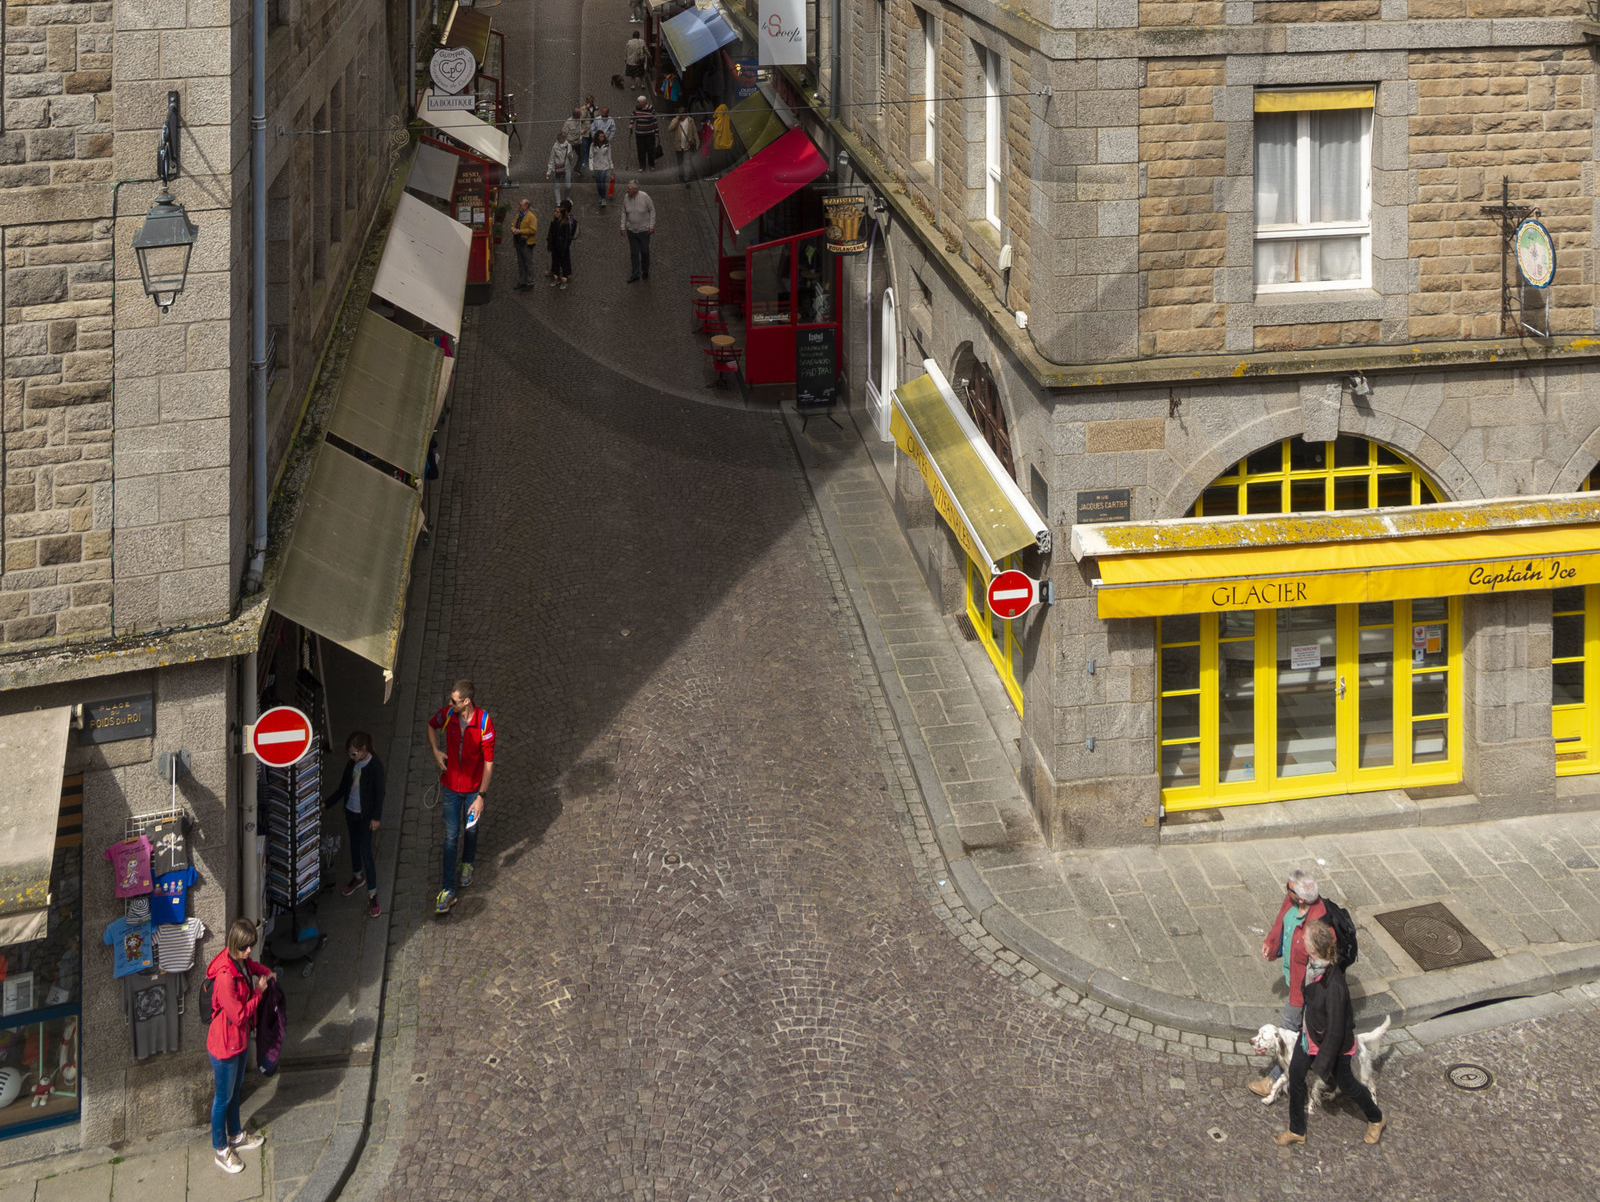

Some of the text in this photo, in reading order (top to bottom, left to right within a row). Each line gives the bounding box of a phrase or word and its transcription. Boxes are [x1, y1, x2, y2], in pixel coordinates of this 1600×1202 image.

[430, 98, 473, 108] LA BOUTIQUE
[1079, 500, 1128, 510] JACQUES CARTIER
[1469, 561, 1576, 590] Captain Ice
[1212, 582, 1307, 606] GLACIER
[100, 702, 130, 710] PLACE
[90, 717, 115, 729] POIDS
[127, 713, 141, 725] ROI
